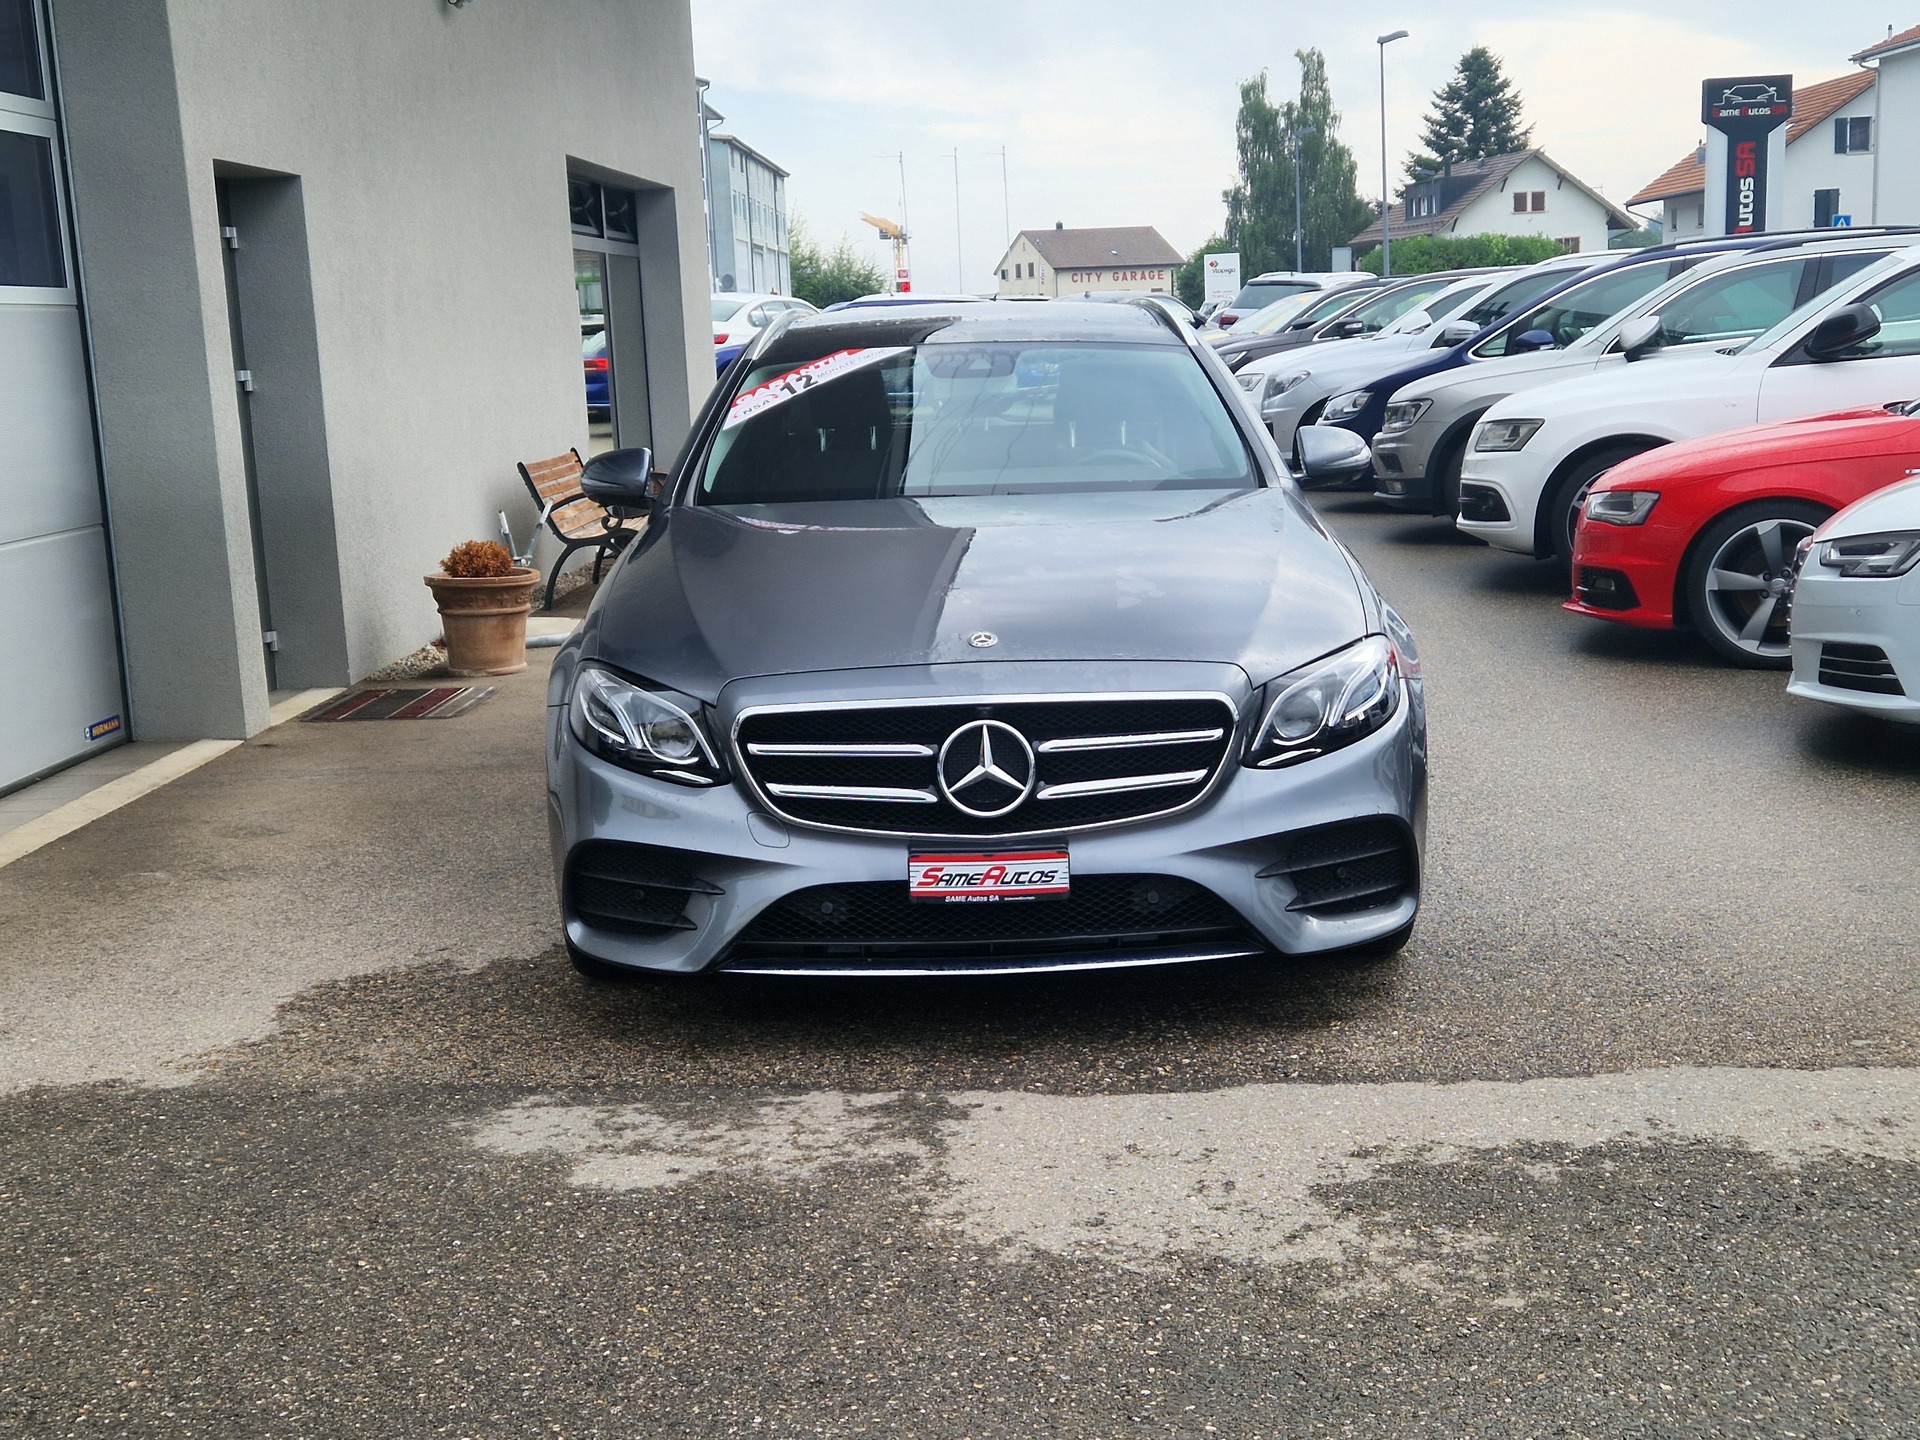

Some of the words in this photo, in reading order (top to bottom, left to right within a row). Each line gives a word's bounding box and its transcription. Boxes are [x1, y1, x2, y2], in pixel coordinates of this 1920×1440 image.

[1071, 272, 1103, 284] CITY
[1112, 269, 1165, 282] GARAGE
[779, 373, 819, 396] 12
[743, 399, 770, 415] NSA
